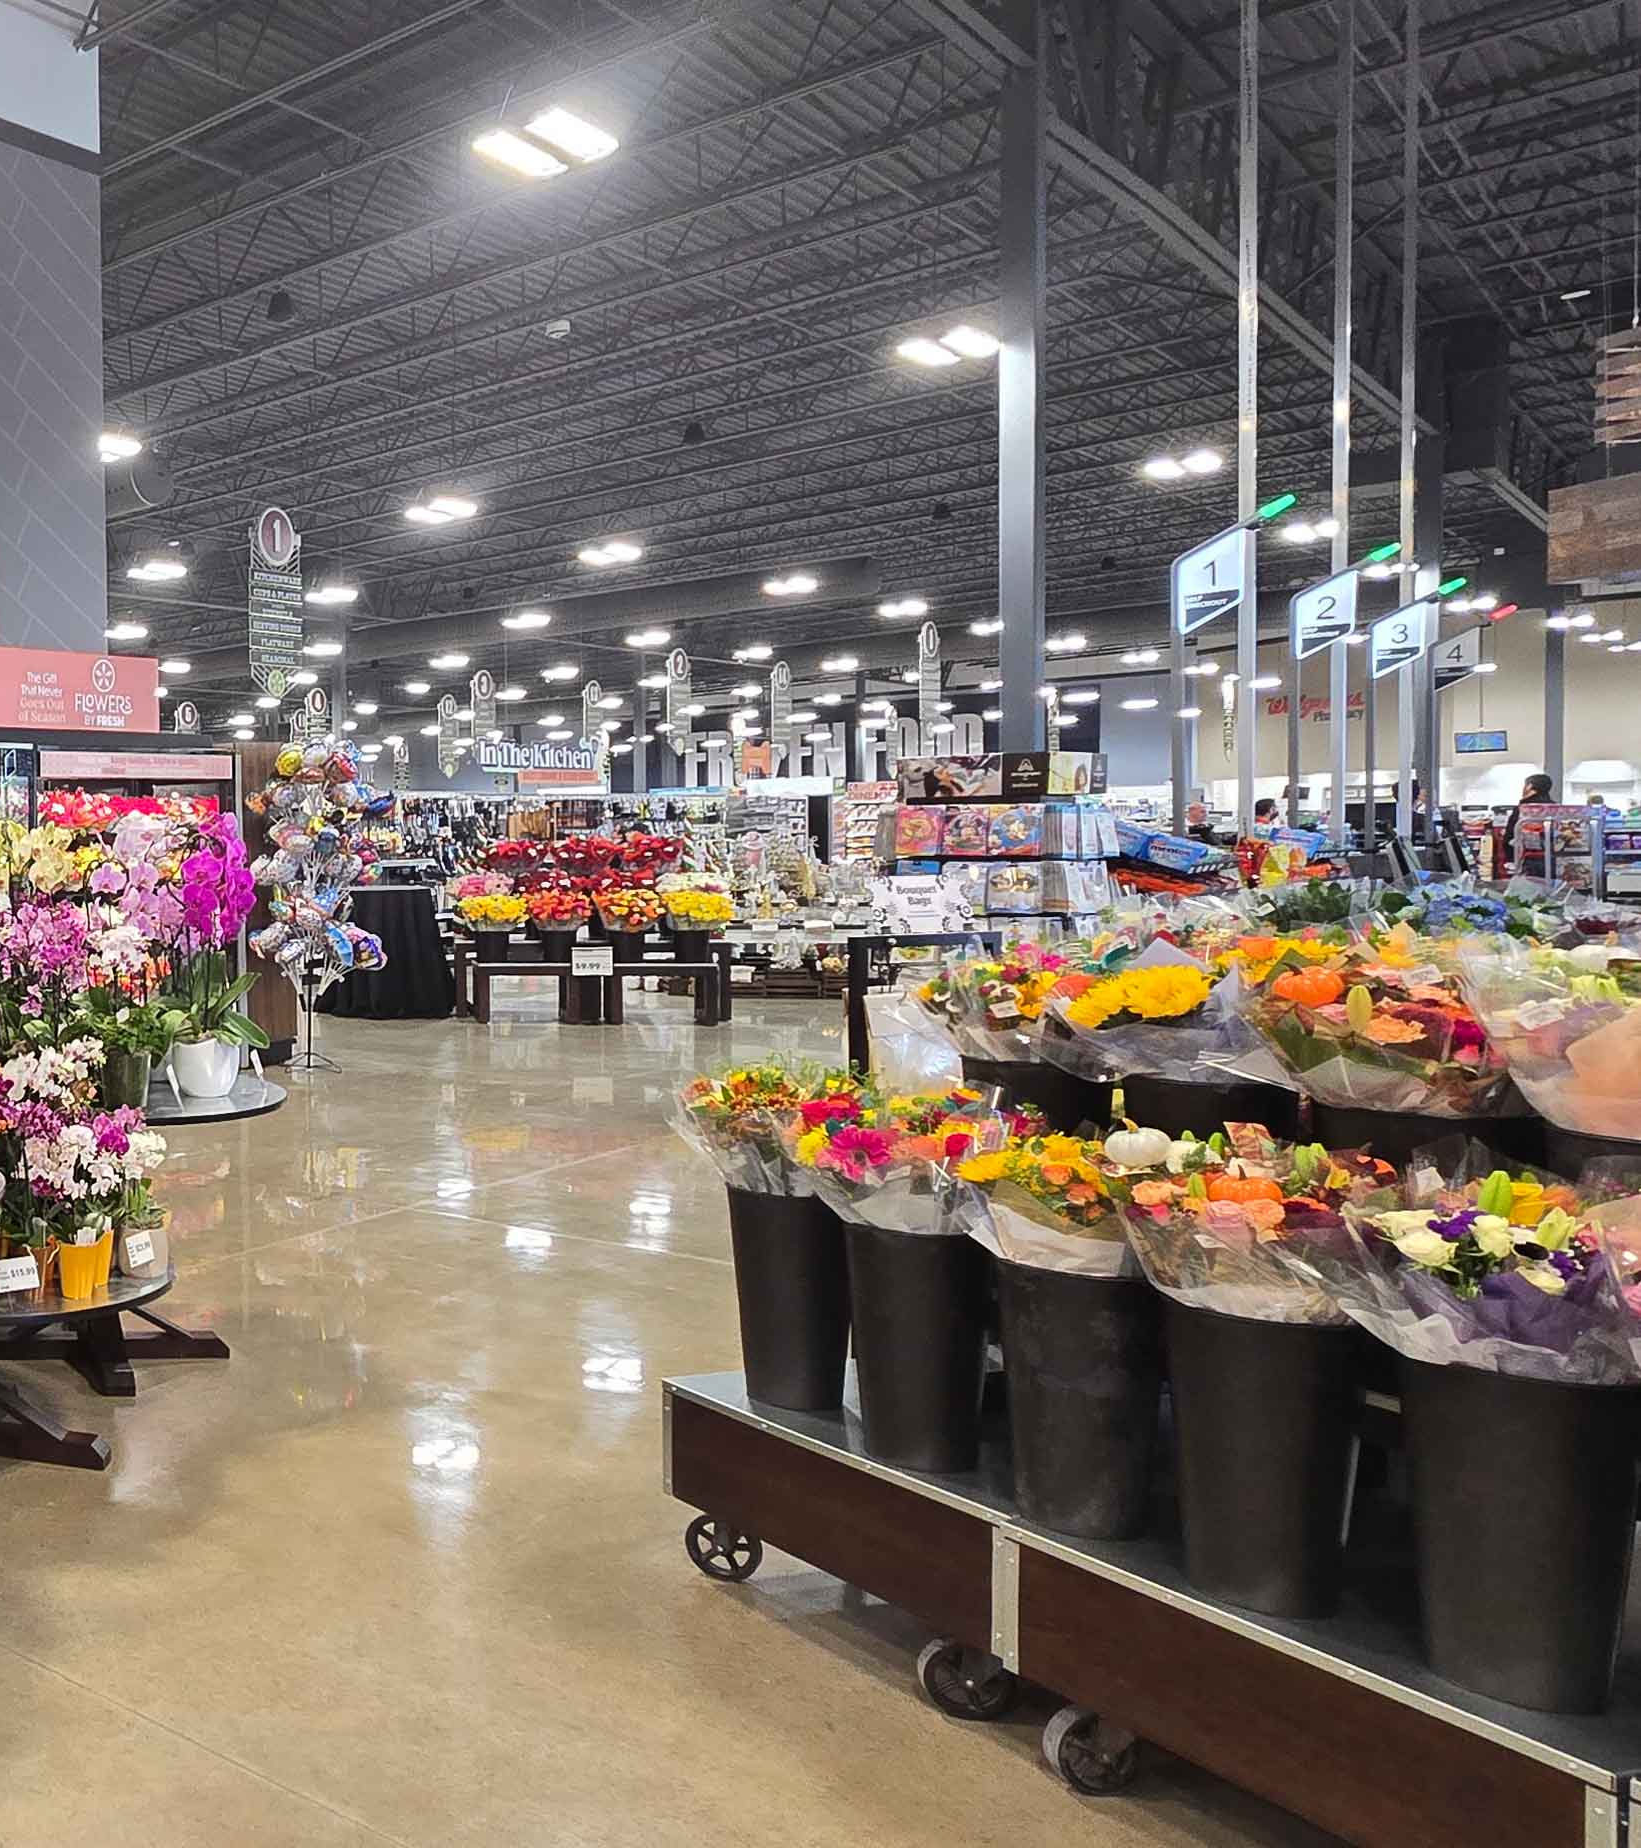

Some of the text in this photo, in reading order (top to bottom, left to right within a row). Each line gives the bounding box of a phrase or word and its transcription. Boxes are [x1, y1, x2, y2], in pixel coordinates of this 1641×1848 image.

[272, 519, 282, 553] 1
[1202, 560, 1217, 587] 1
[1315, 596, 1337, 620] 2
[1391, 623, 1408, 644] 3
[1446, 643, 1463, 662] 4
[38, 685, 63, 698] Never
[74, 692, 134, 714] FLOWERS
[84, 715, 126, 727] BY FRESH
[479, 741, 593, 770] In The Kitchen
[685, 721, 847, 787] FREN
[896, 885, 937, 897] Bouquet
